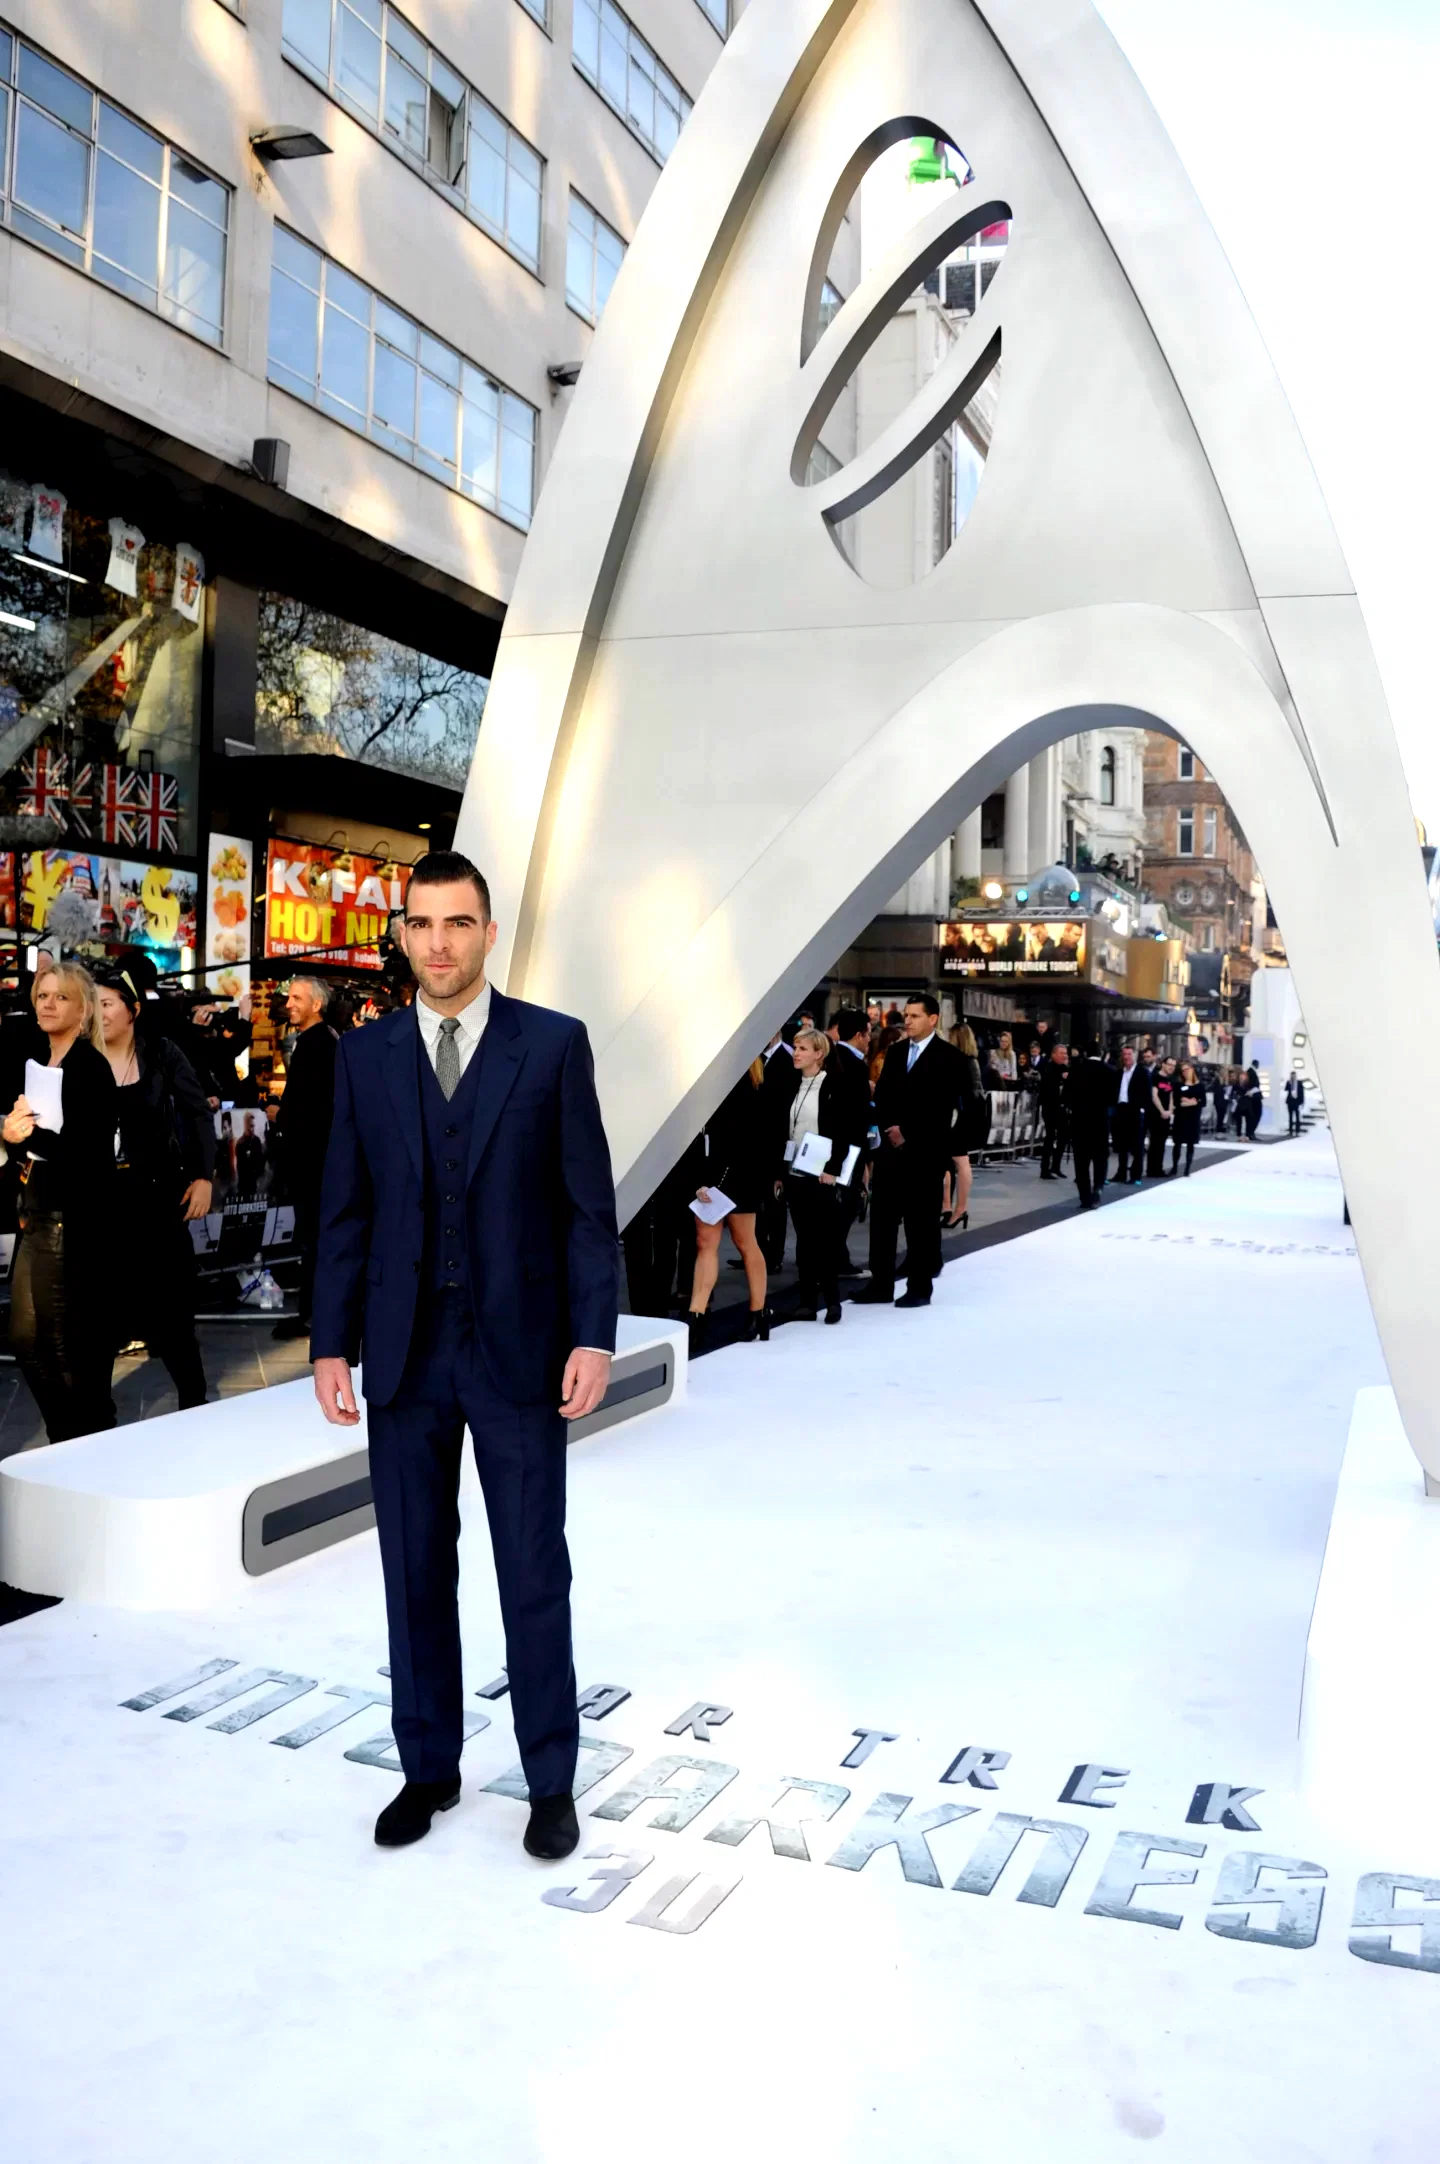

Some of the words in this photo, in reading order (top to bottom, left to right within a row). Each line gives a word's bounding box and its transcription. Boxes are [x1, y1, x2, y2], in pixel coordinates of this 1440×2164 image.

[270, 899, 336, 944] HOT
[117, 1657, 491, 1772] INTO
[479, 1735, 1440, 1974] DARKNESS
[839, 1727, 1266, 1832] TREK
[541, 1842, 744, 1935] 3D
